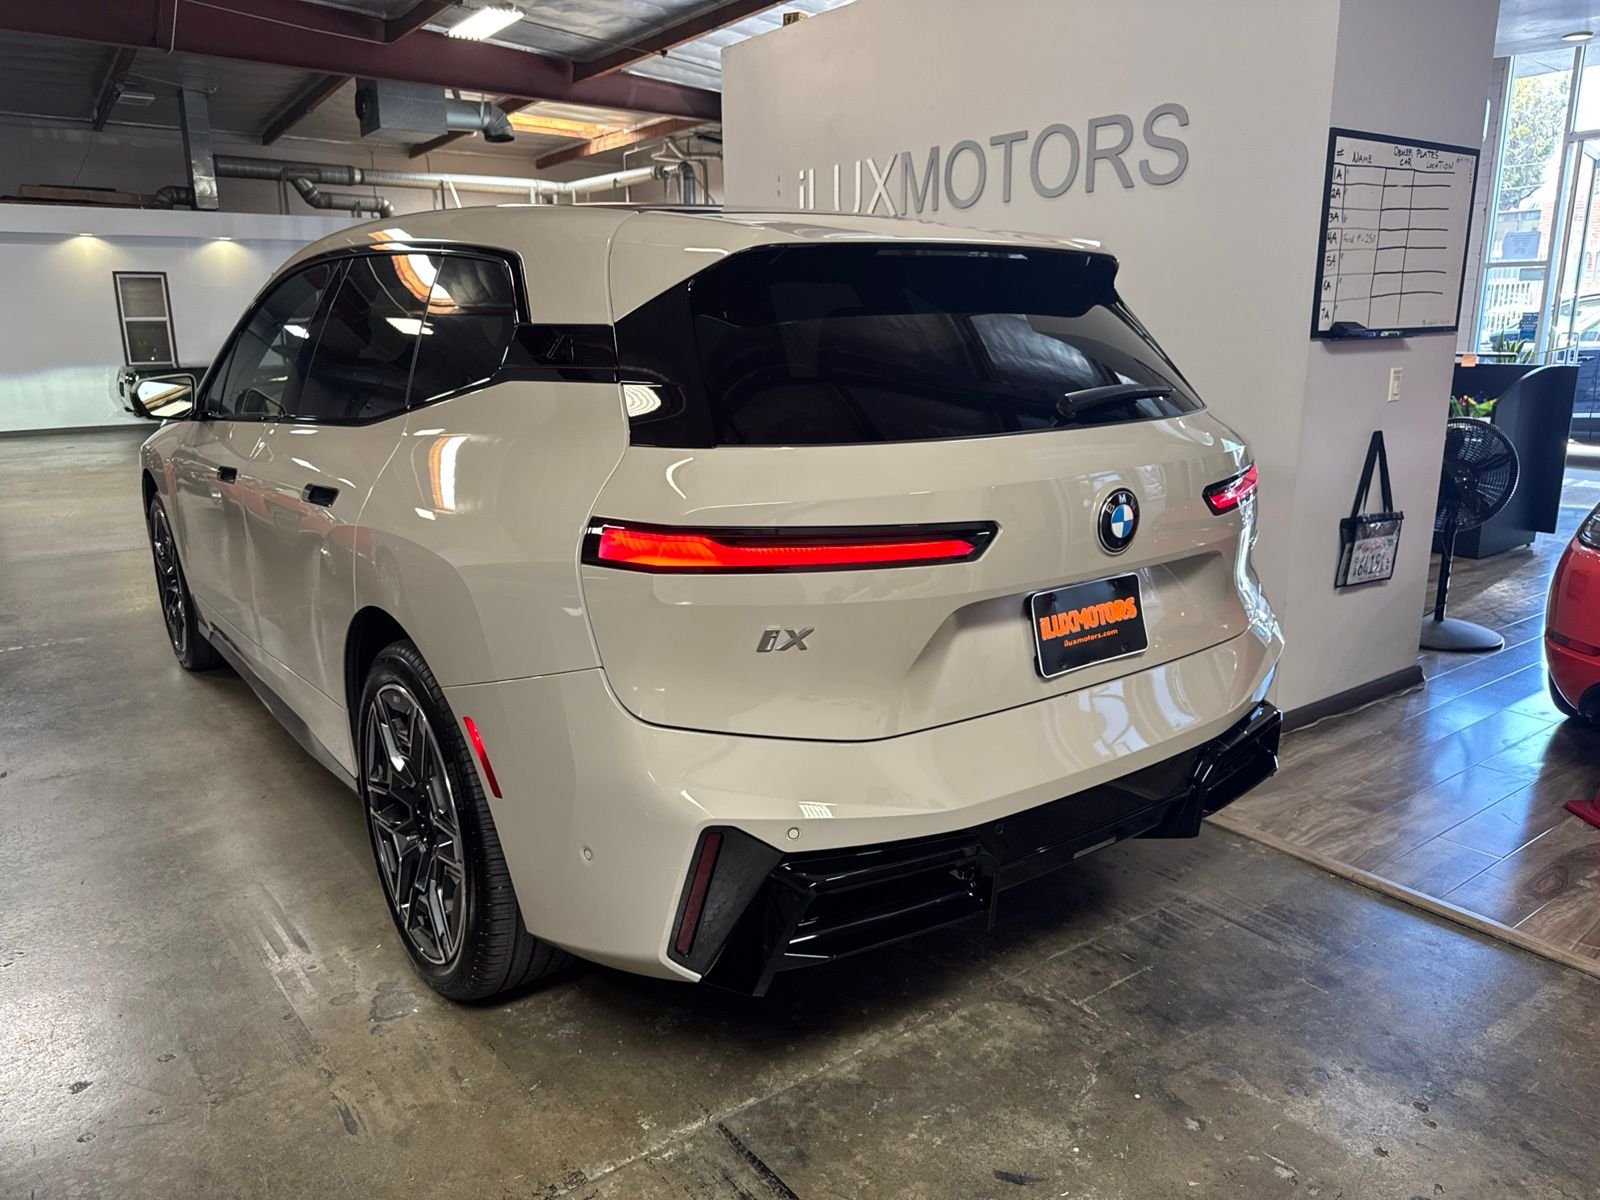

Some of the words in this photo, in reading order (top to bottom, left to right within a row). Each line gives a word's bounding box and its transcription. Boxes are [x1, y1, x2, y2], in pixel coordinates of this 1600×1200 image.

[799, 103, 1190, 217] iLUXMOTORS
[1352, 151, 1373, 164] NAME
[1400, 158, 1412, 167] CAR
[1426, 160, 1454, 170] LOCATION
[1416, 150, 1439, 159] PLATES
[1330, 188, 1341, 199] 2A
[1328, 212, 1339, 223] 3A
[1326, 253, 1336, 267] 5A
[1105, 494, 1137, 514] BMW
[1039, 597, 1137, 641] iLUXMOTORS
[1063, 628, 1119, 647] iluxmotors.com
